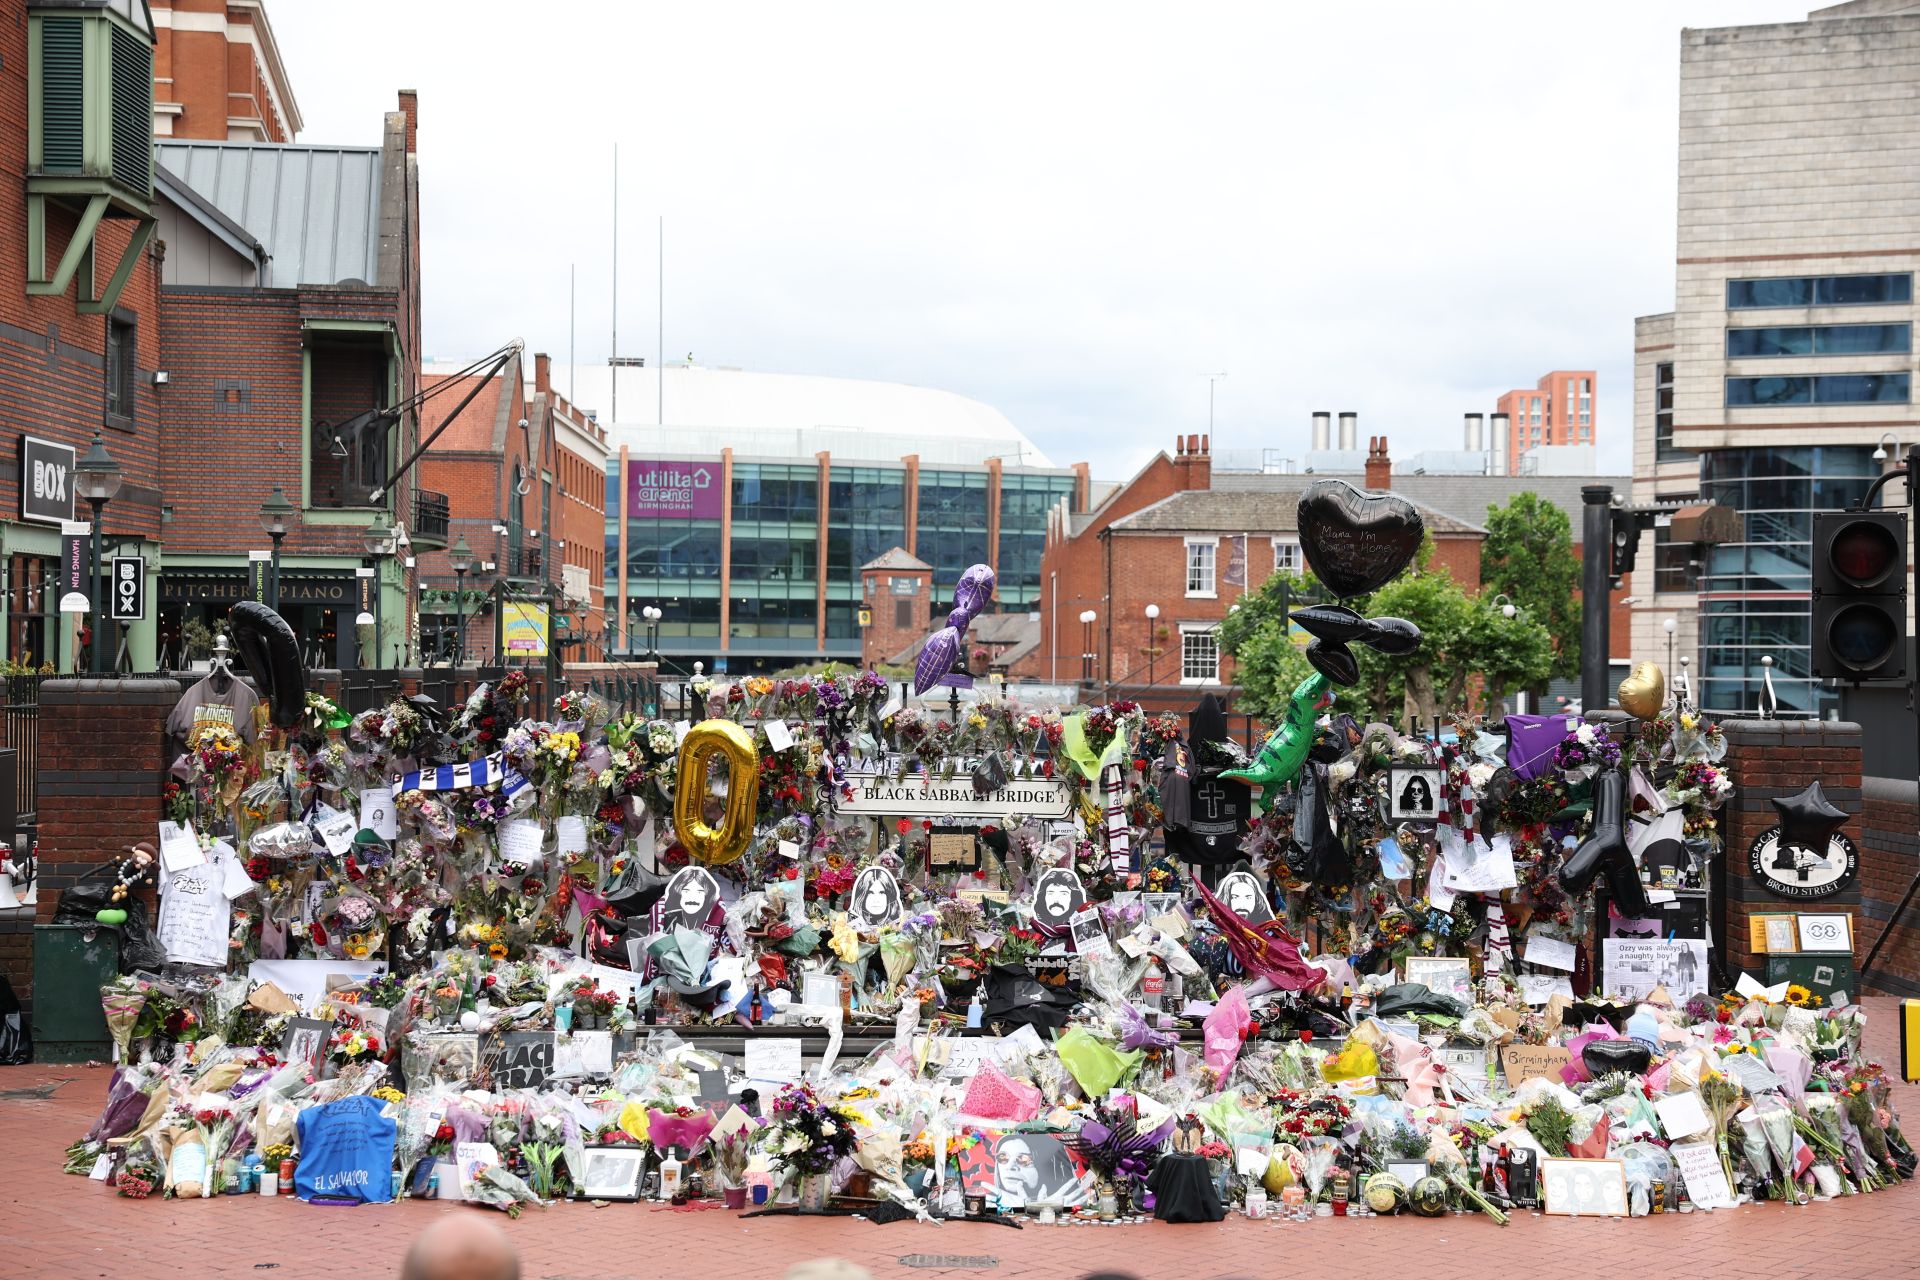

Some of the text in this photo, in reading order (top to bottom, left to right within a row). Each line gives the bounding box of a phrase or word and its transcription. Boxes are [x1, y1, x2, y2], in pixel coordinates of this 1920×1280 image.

[34, 459, 66, 502] BOX
[638, 470, 691, 488] utilita
[639, 488, 693, 502] arena
[638, 502, 694, 510] BIRMINGHAM
[1321, 525, 1352, 539] Mama
[71, 539, 80, 588] HAVING FUN
[119, 563, 136, 613] BOX
[280, 586, 343, 599] PIANO
[864, 787, 914, 801] BLACK
[996, 790, 1055, 803] BRIDGE
[1766, 879, 1838, 896] BROAD STREET
[1619, 944, 1636, 952] Ozzy
[1024, 957, 1069, 968] Sabbath
[330, 991, 361, 1005] OZZY
[1508, 1051, 1568, 1069] Birmingham
[315, 1176, 325, 1190] EL
